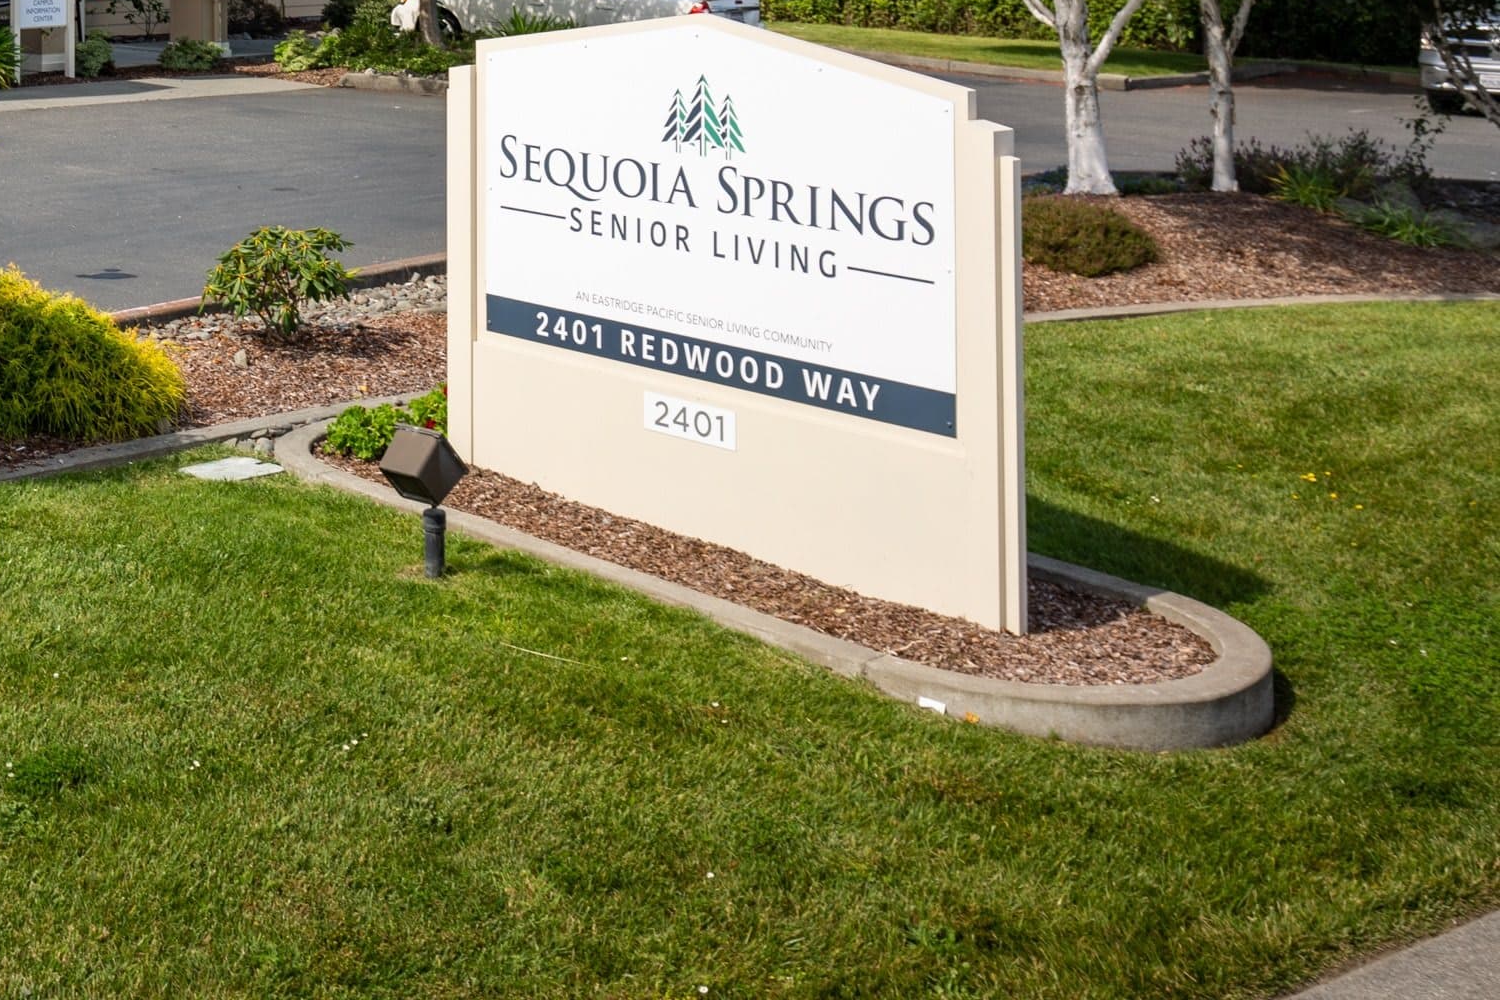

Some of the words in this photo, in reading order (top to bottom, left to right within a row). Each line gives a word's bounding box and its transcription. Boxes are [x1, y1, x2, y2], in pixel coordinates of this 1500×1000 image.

[26, 6, 61, 14] INFORMATION
[500, 134, 698, 208] SEQUOIA
[717, 166, 935, 246] SPRINGS
[569, 208, 691, 252] SENIOR
[713, 231, 837, 279] LIVING
[575, 291, 590, 302] AN
[592, 294, 644, 314] EASTRIDGE
[646, 305, 684, 322] PACIFIC
[686, 313, 724, 331] SENIOR
[727, 321, 760, 338] LIVING
[763, 328, 834, 353] COMMUNITY
[535, 311, 603, 349] 2401
[621, 329, 783, 389] REDWOOD
[803, 368, 881, 411] WAY
[654, 401, 725, 442] 2401
